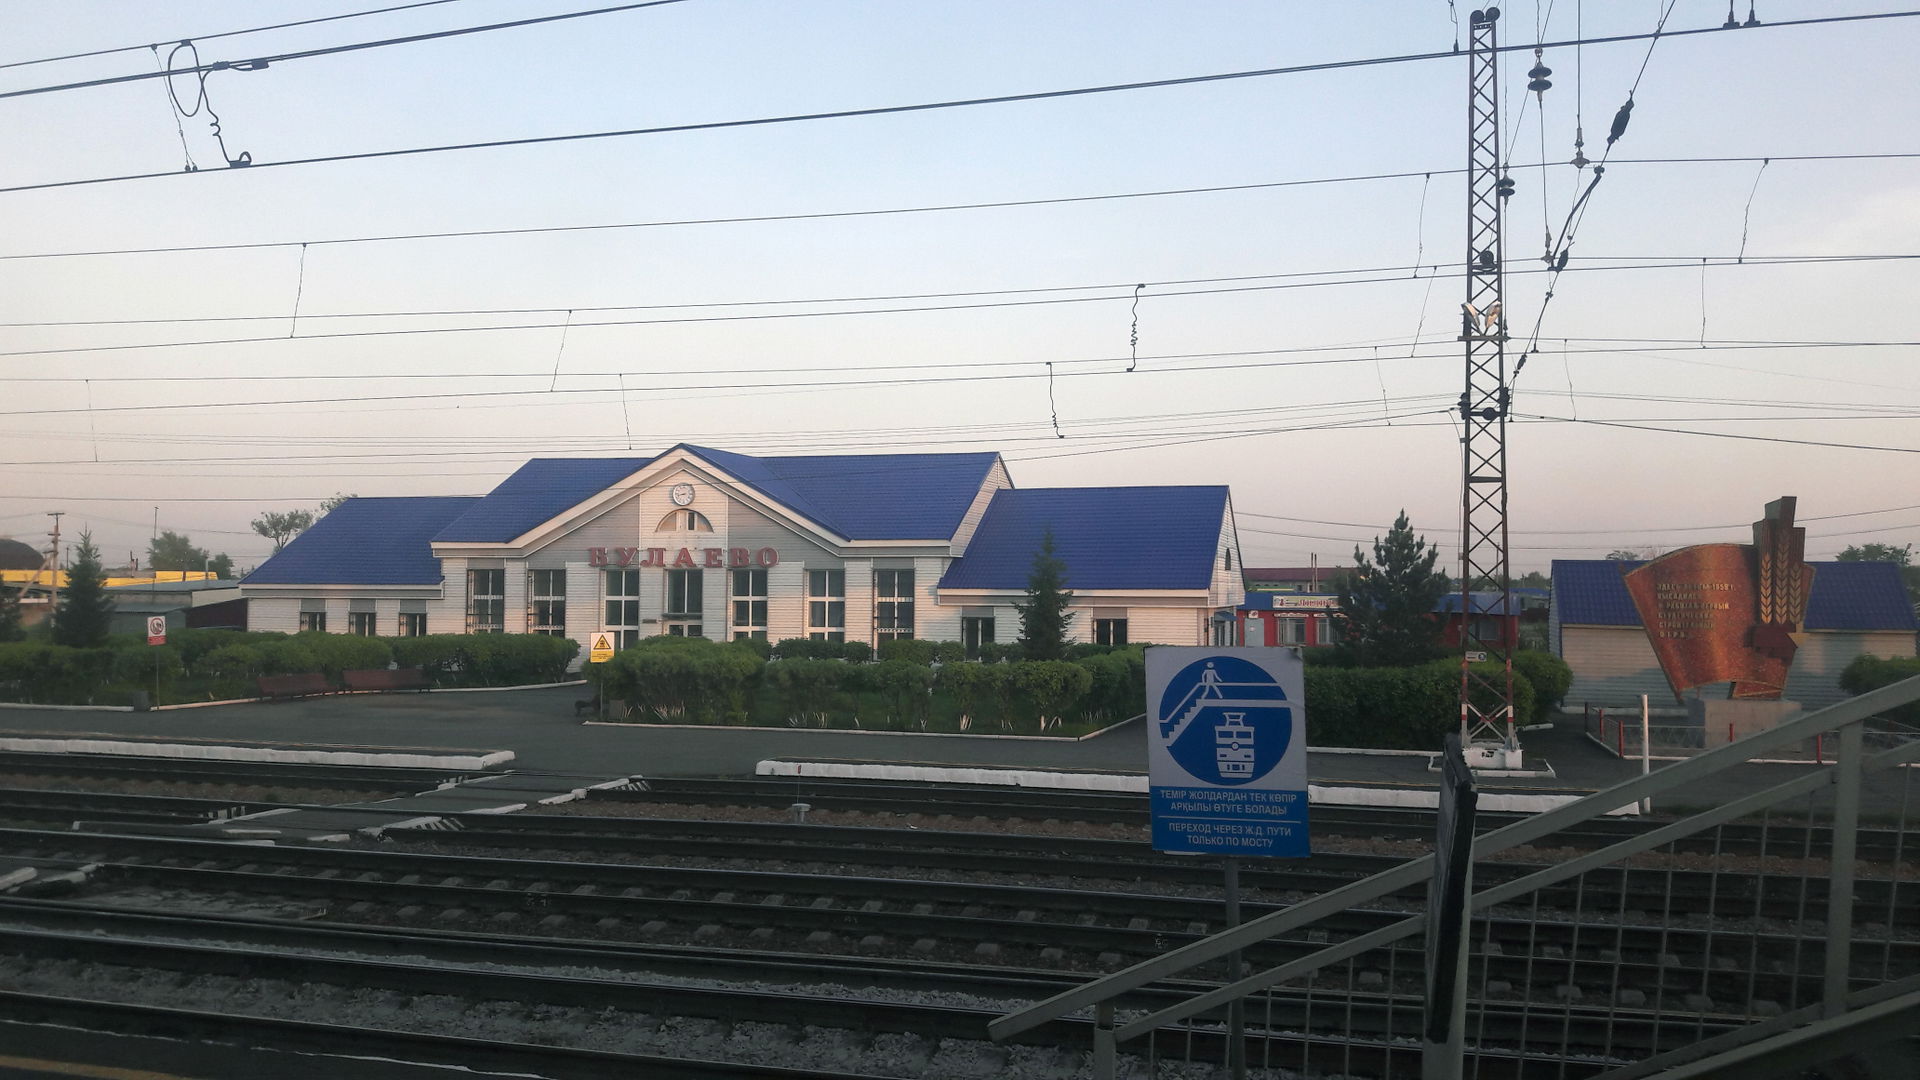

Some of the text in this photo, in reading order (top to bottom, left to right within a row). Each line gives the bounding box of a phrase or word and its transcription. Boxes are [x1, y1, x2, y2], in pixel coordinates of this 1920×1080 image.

[588, 546, 780, 568] БУЛАЕВО
[1160, 789, 1297, 803] ТЕМІР ЖОЛДАРДАН ТЕК КӨПІР
[1170, 802, 1288, 816] АРҚЫЛЫ ӨТУГЕ БОЛАДЫ
[1169, 823, 1211, 834] ПЕРЕХОД
[1213, 824, 1243, 834] ЧЕРЕЗ
[1267, 827, 1292, 837] ПУТИ
[1186, 835, 1274, 848] ТОЛЬКО ПО МОСТУ
